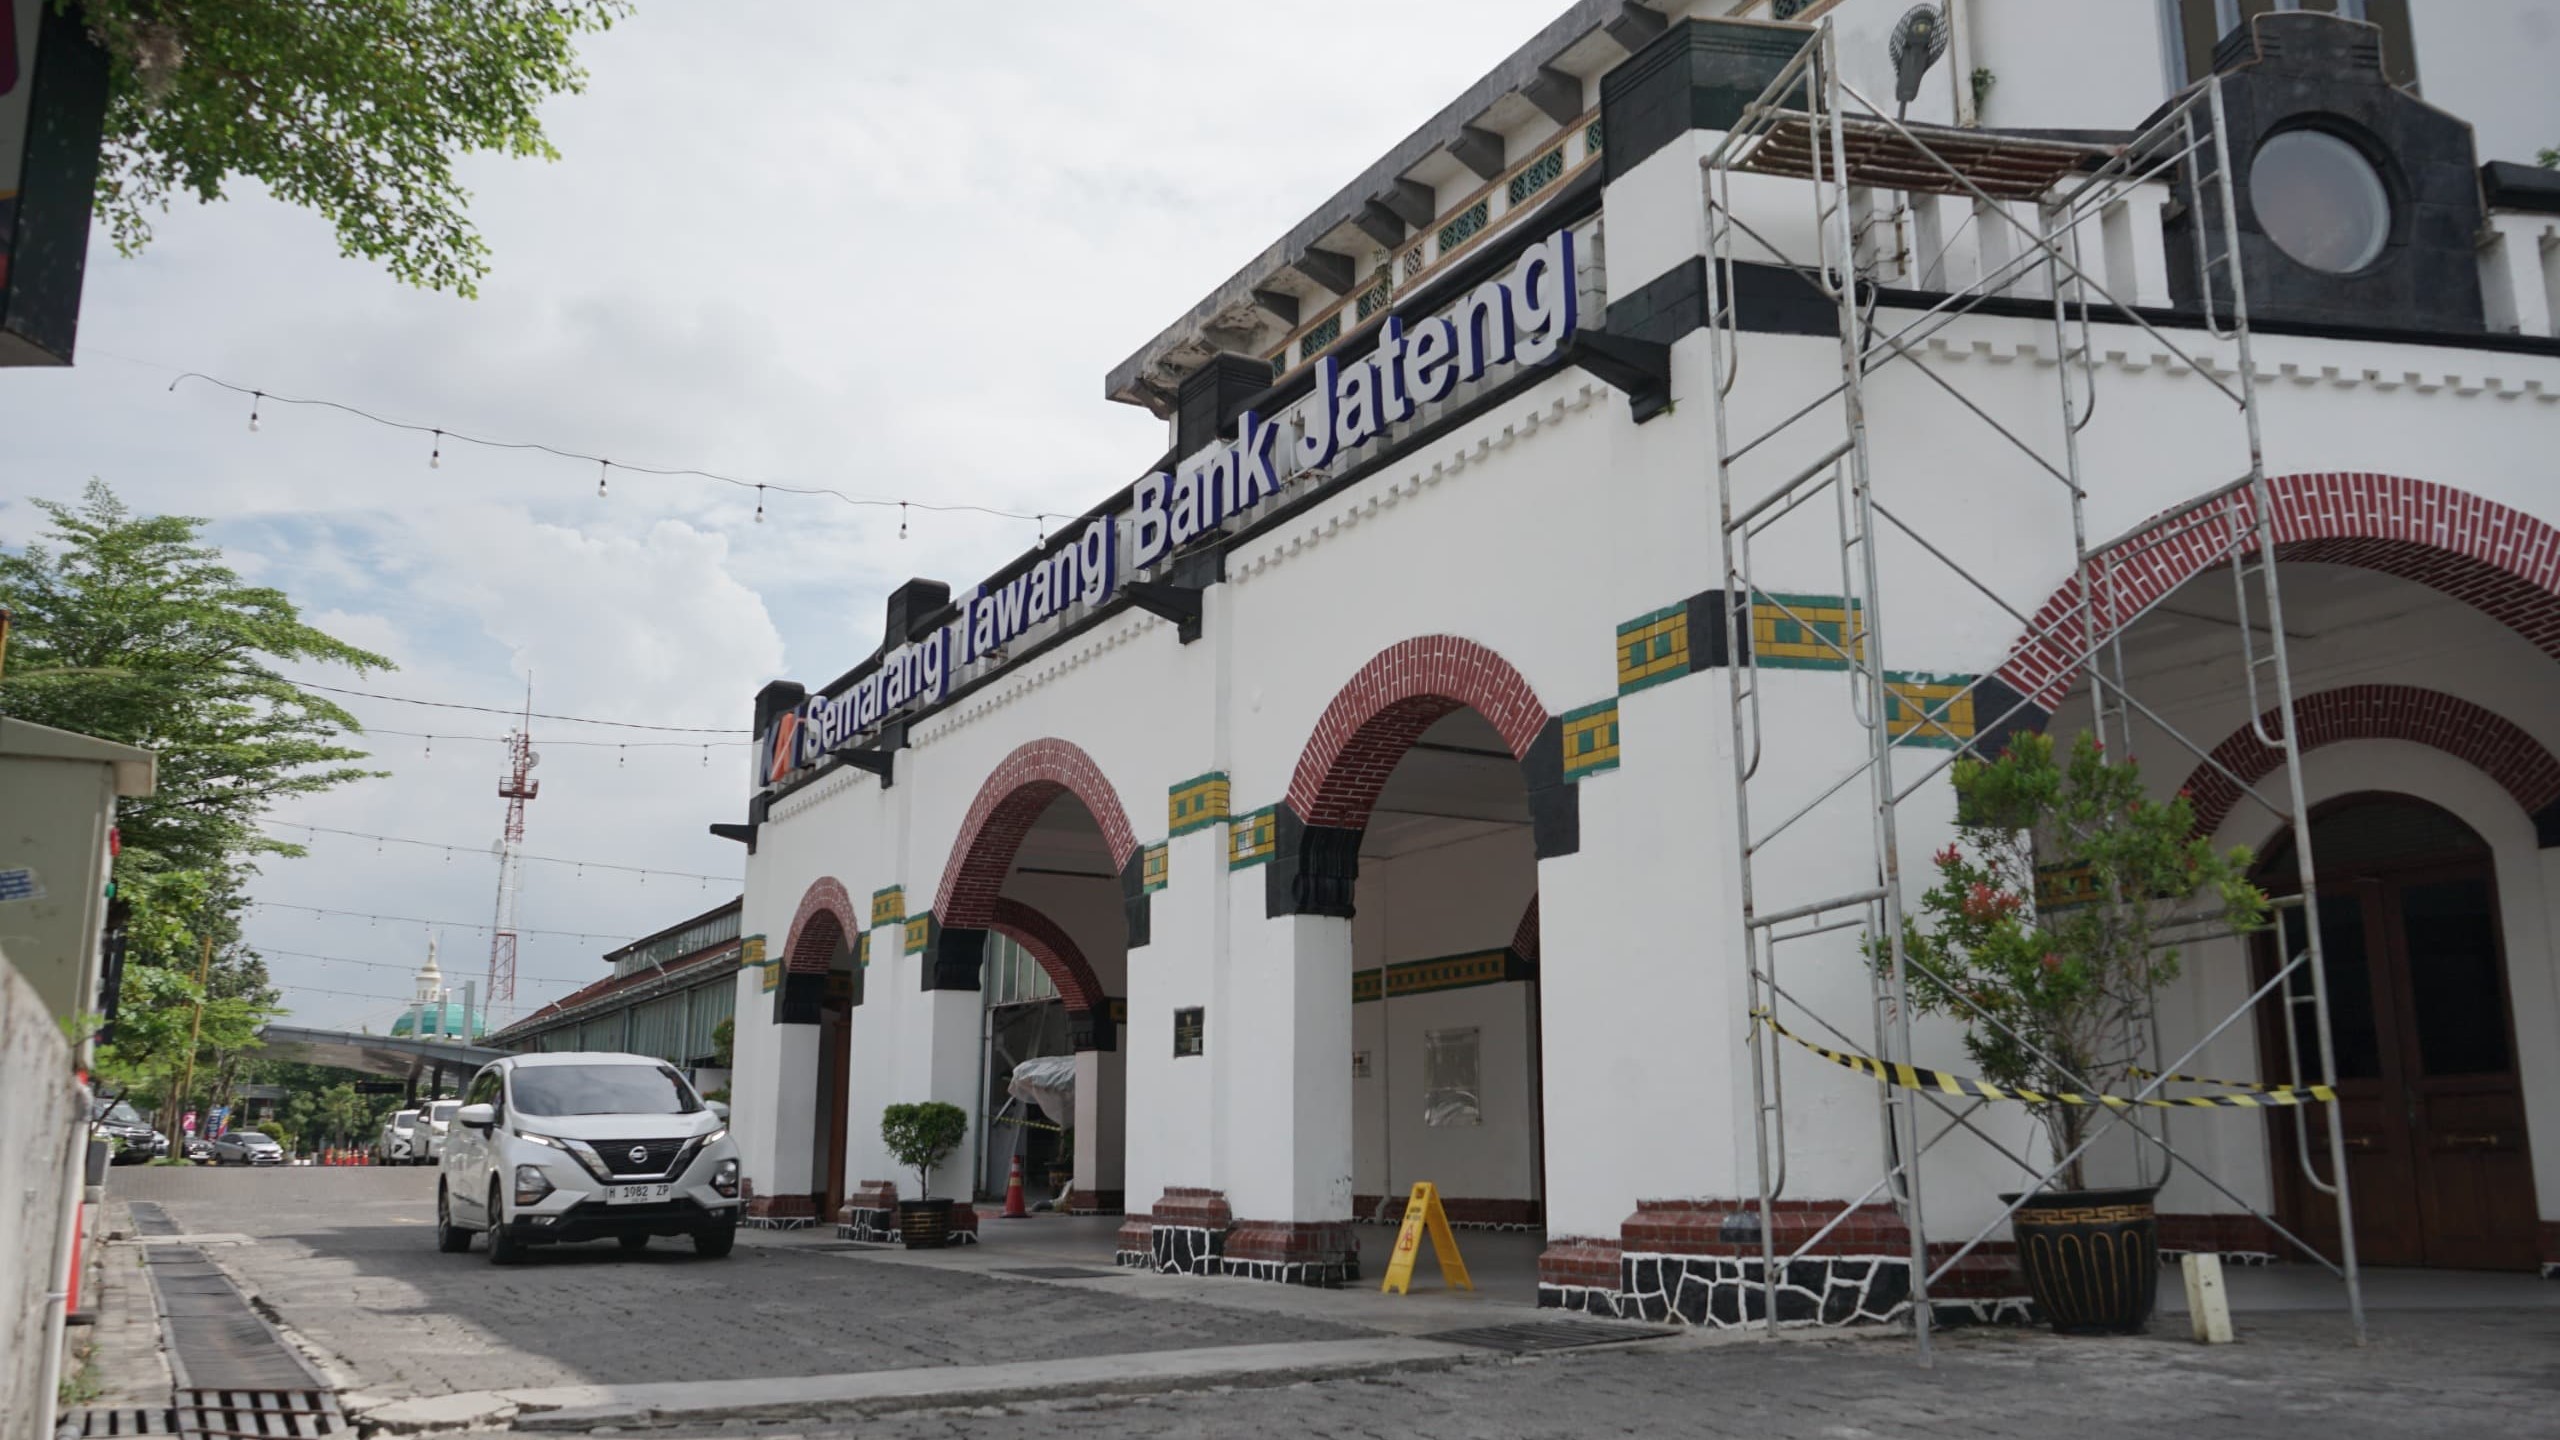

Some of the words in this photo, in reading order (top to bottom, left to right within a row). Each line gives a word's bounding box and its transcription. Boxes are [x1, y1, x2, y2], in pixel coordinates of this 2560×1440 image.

[806, 626, 949, 759] Semarang
[956, 513, 1116, 665] Tawang
[1133, 410, 1280, 569] Bank
[1296, 229, 1577, 469] Jateng
